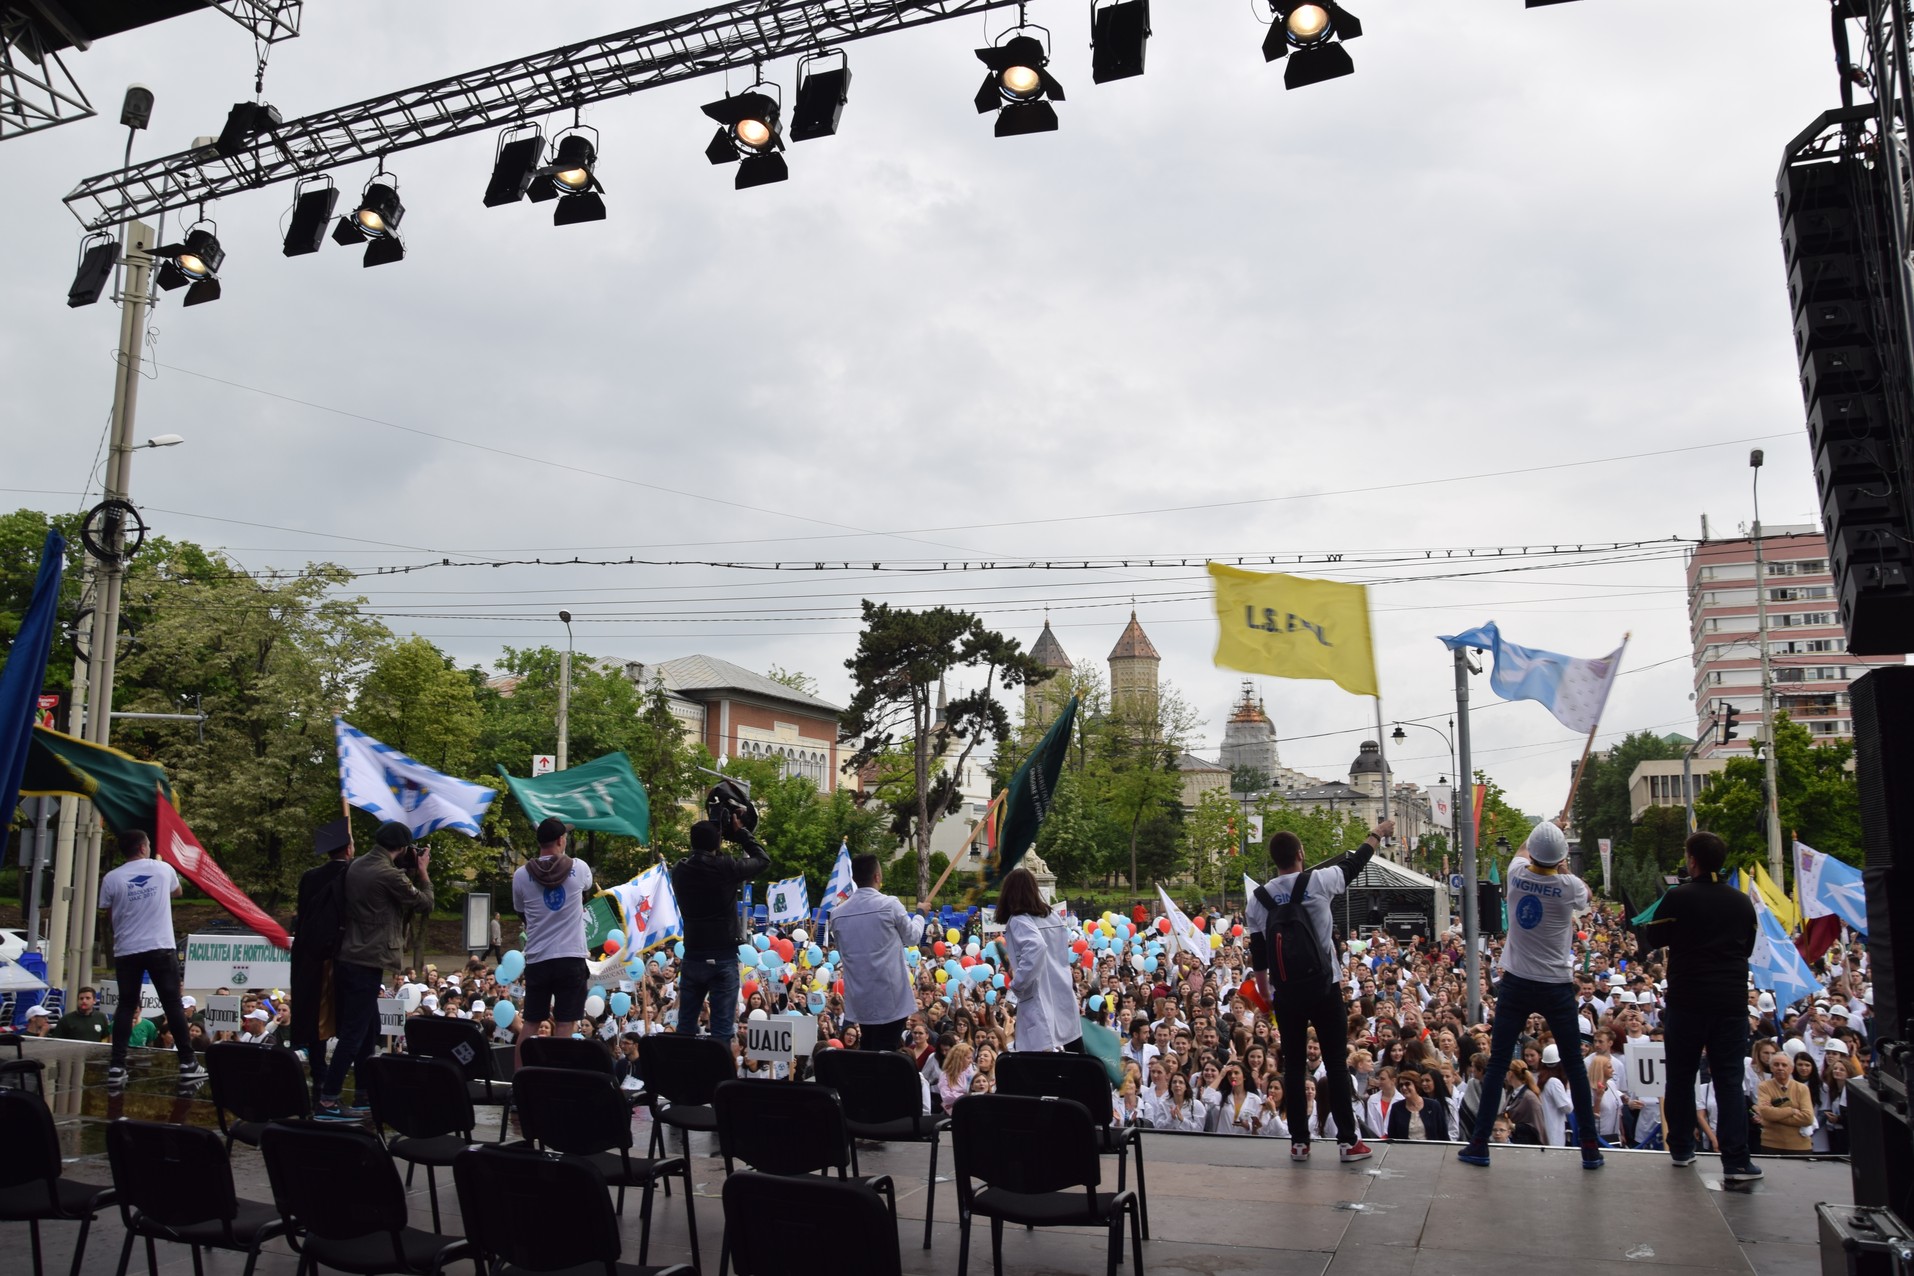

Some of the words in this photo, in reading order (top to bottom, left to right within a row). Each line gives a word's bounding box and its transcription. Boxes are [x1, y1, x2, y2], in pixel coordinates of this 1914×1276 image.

[1511, 876, 1562, 898] INGINER
[188, 943, 231, 961] FACULTATEA
[232, 944, 243, 961] DE
[243, 944, 291, 962] HORTICULTUR
[106, 987, 120, 1007] Enes
[141, 991, 163, 1009] Enesc
[205, 1002, 239, 1026] Agronomie
[380, 1007, 405, 1027] onomie
[748, 1028, 792, 1052] U.A.I.C
